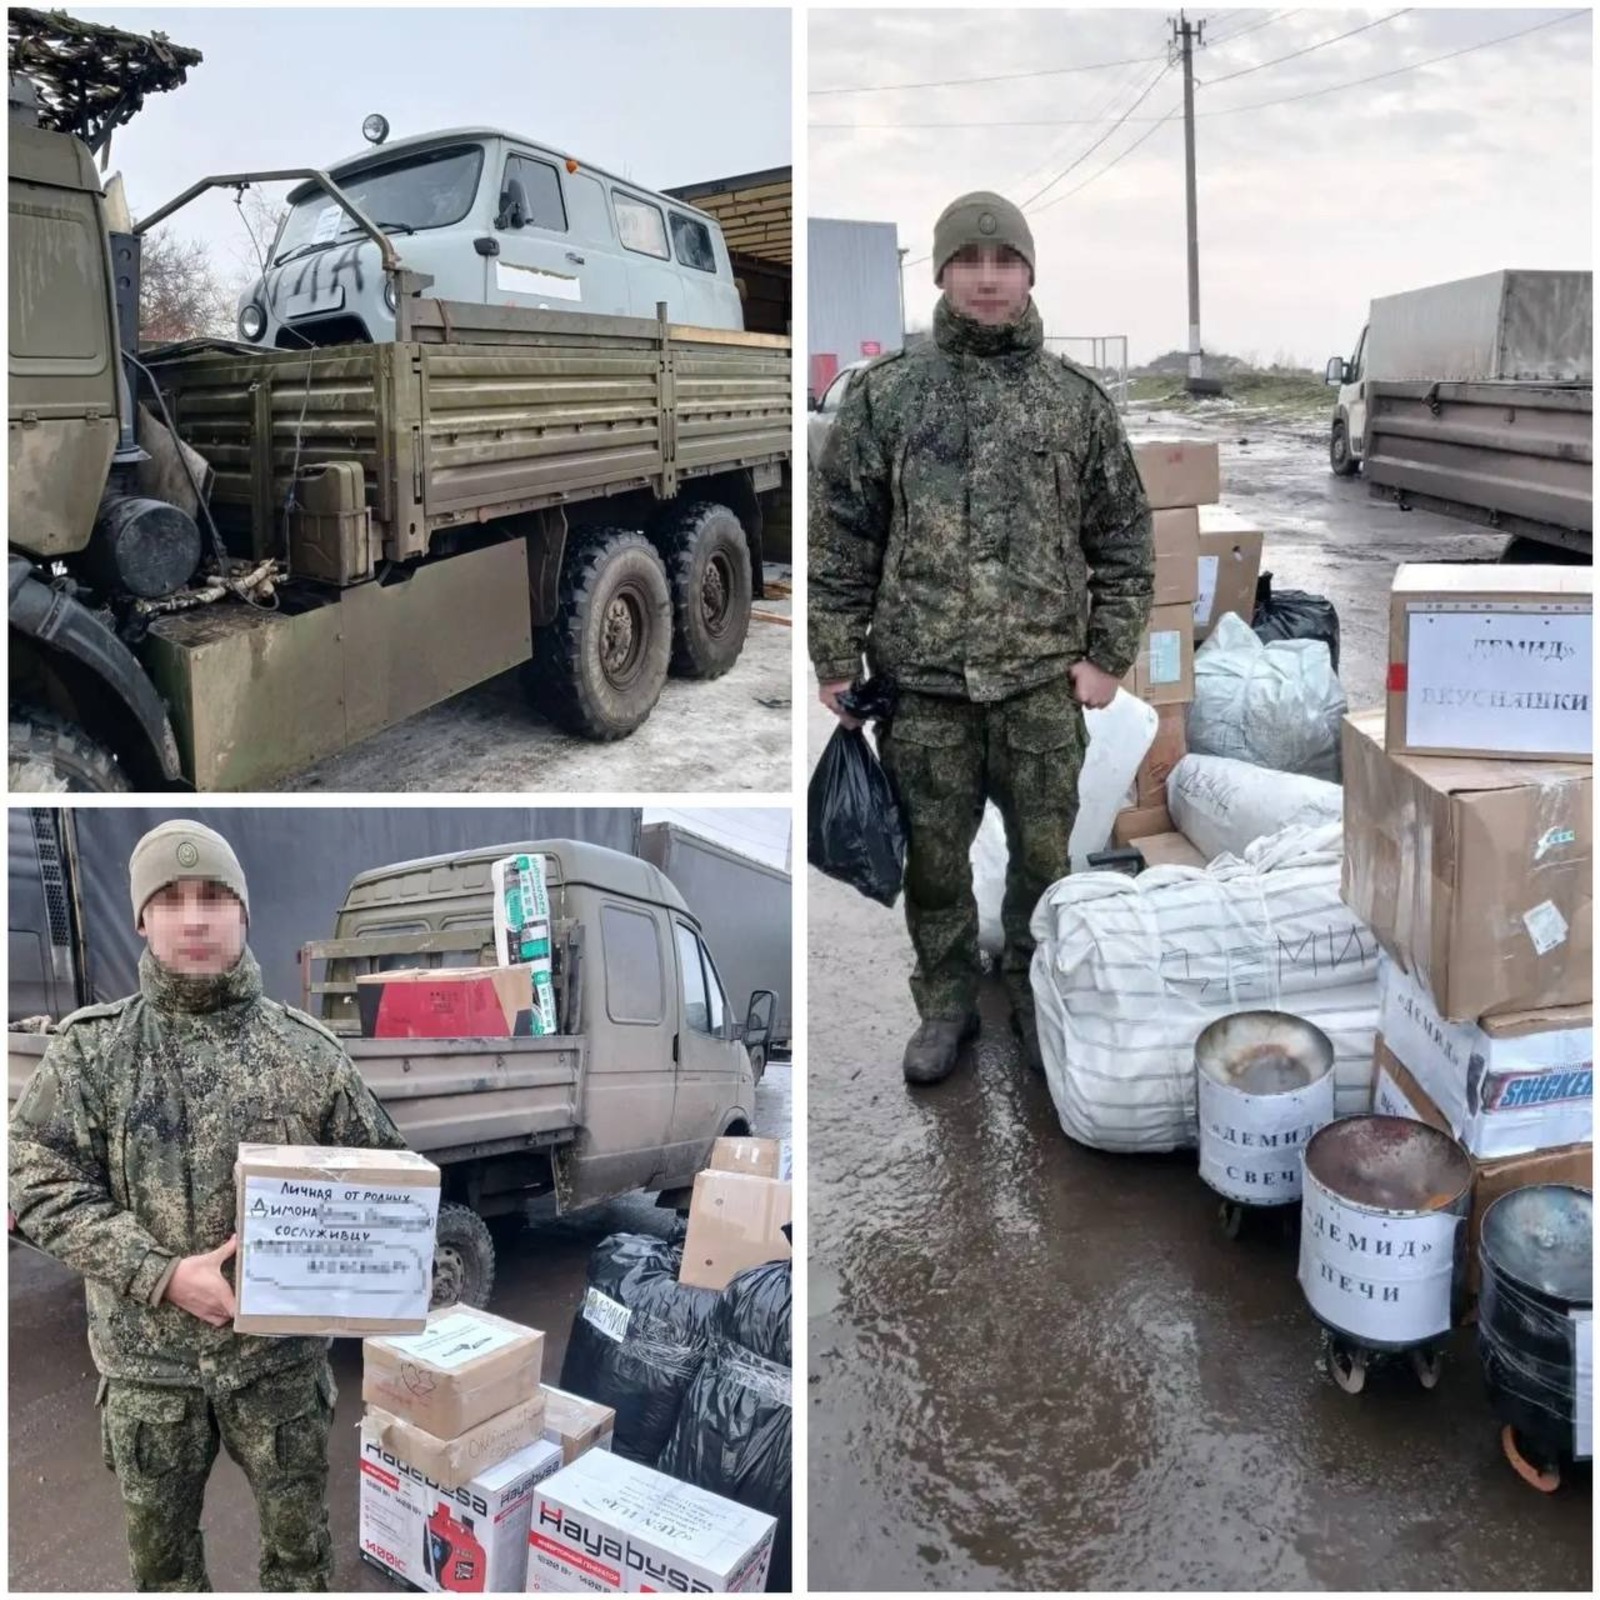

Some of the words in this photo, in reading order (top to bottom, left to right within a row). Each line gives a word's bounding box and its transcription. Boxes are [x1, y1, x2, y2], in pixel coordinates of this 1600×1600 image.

[1159, 924, 1379, 994] ДЕМИ
[1499, 1070, 1593, 1106] SNICKE
[281, 1182, 333, 1200] ЛИЧНАЯ
[344, 1191, 360, 1201] ОТ
[275, 1224, 371, 1242] СОСЛУЖИВЦУ
[1320, 1262, 1399, 1301] ПЕЧИ
